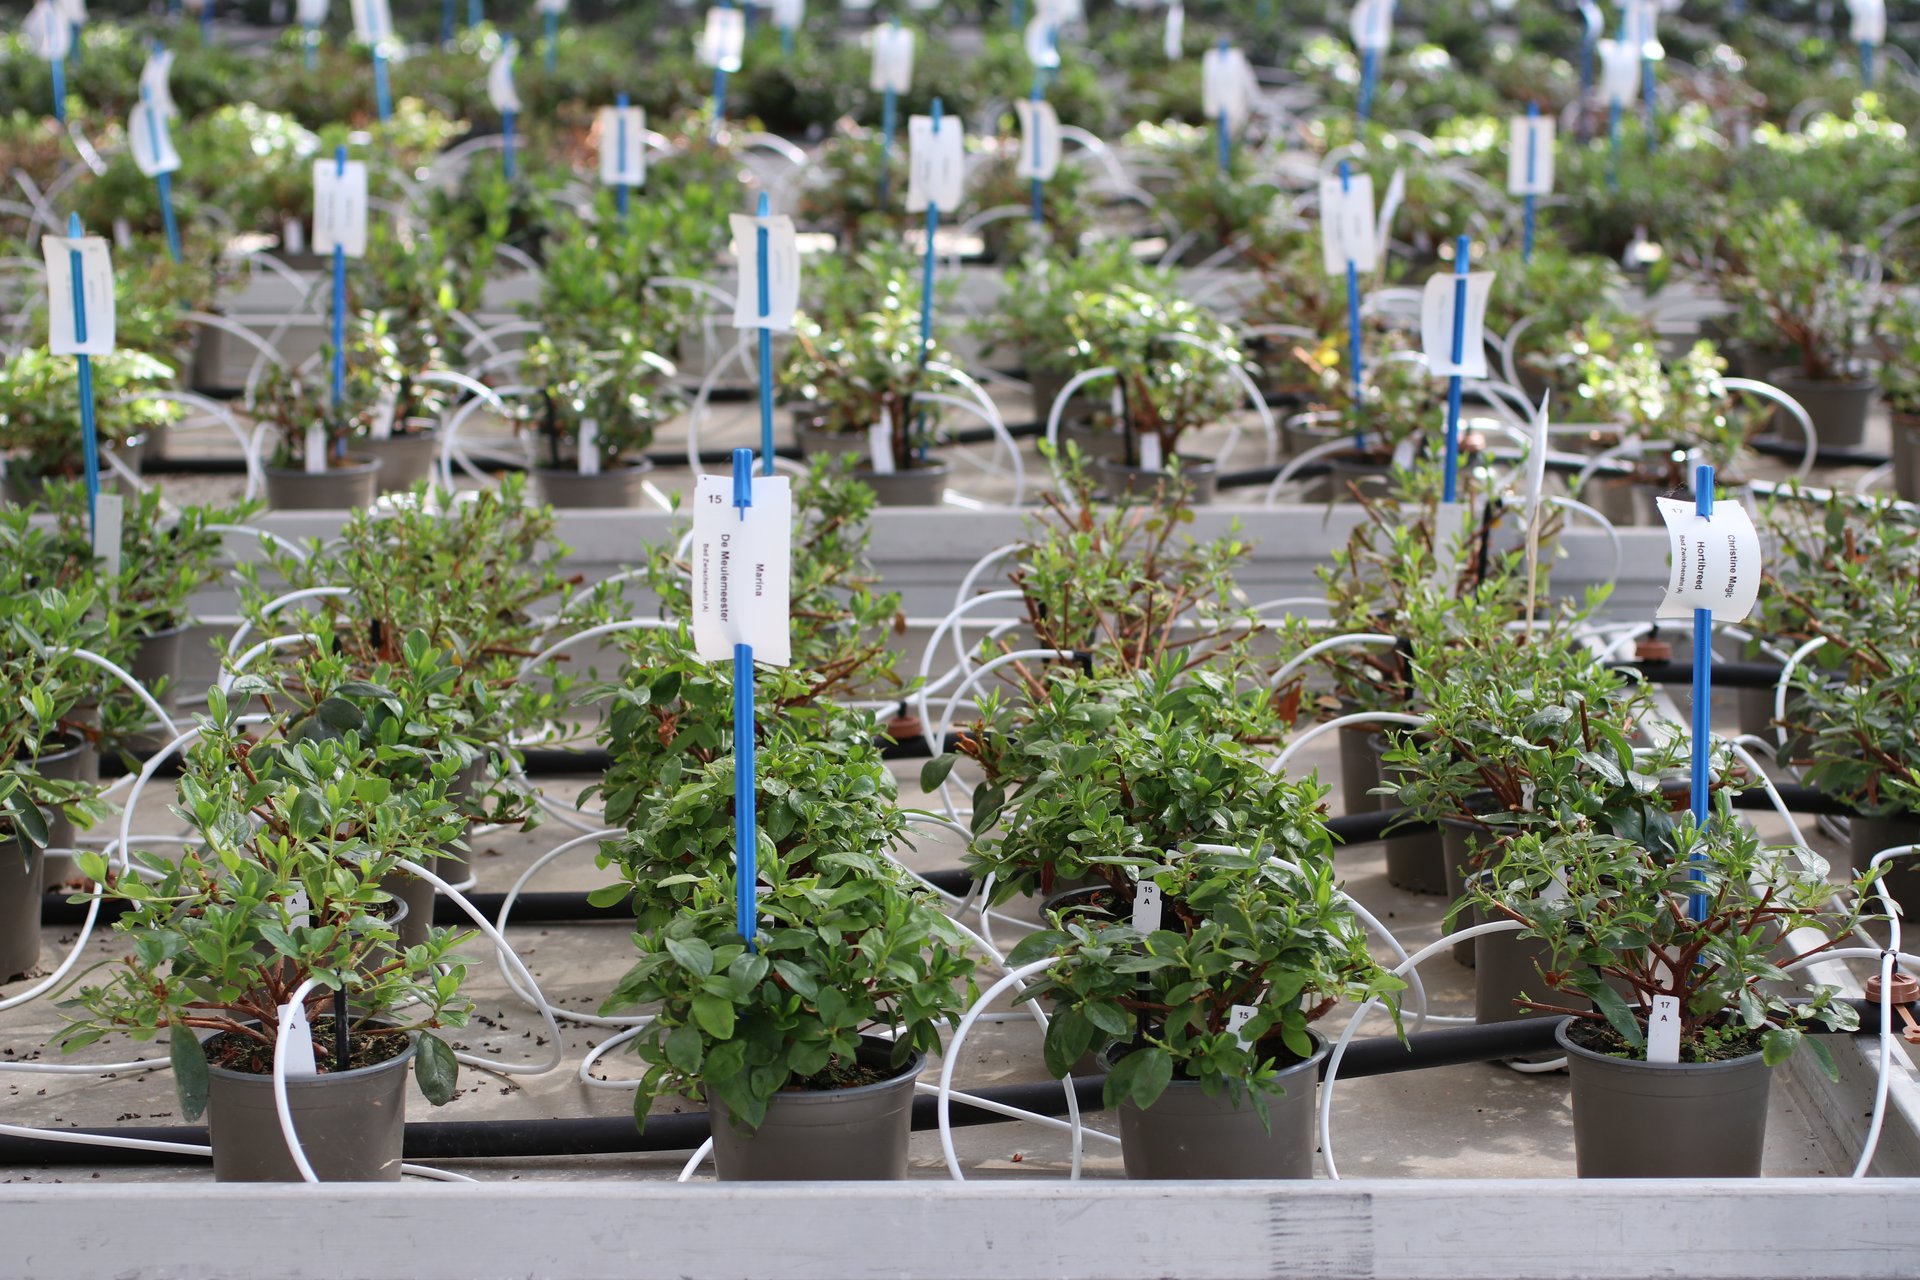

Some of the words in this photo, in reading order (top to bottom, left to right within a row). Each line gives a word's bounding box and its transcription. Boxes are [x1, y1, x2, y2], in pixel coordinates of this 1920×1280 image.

[708, 494, 722, 504] 15
[720, 533, 731, 548] De
[1727, 534, 1738, 573] Christine
[1695, 541, 1706, 590] Hortibreed
[720, 551, 730, 622] Meulemeester
[755, 563, 765, 597] Marina
[1725, 576, 1738, 599] Magic
[1660, 1001, 1671, 1009] 17
[1238, 1011, 1249, 1019] 15
[1660, 1014, 1668, 1022] A
